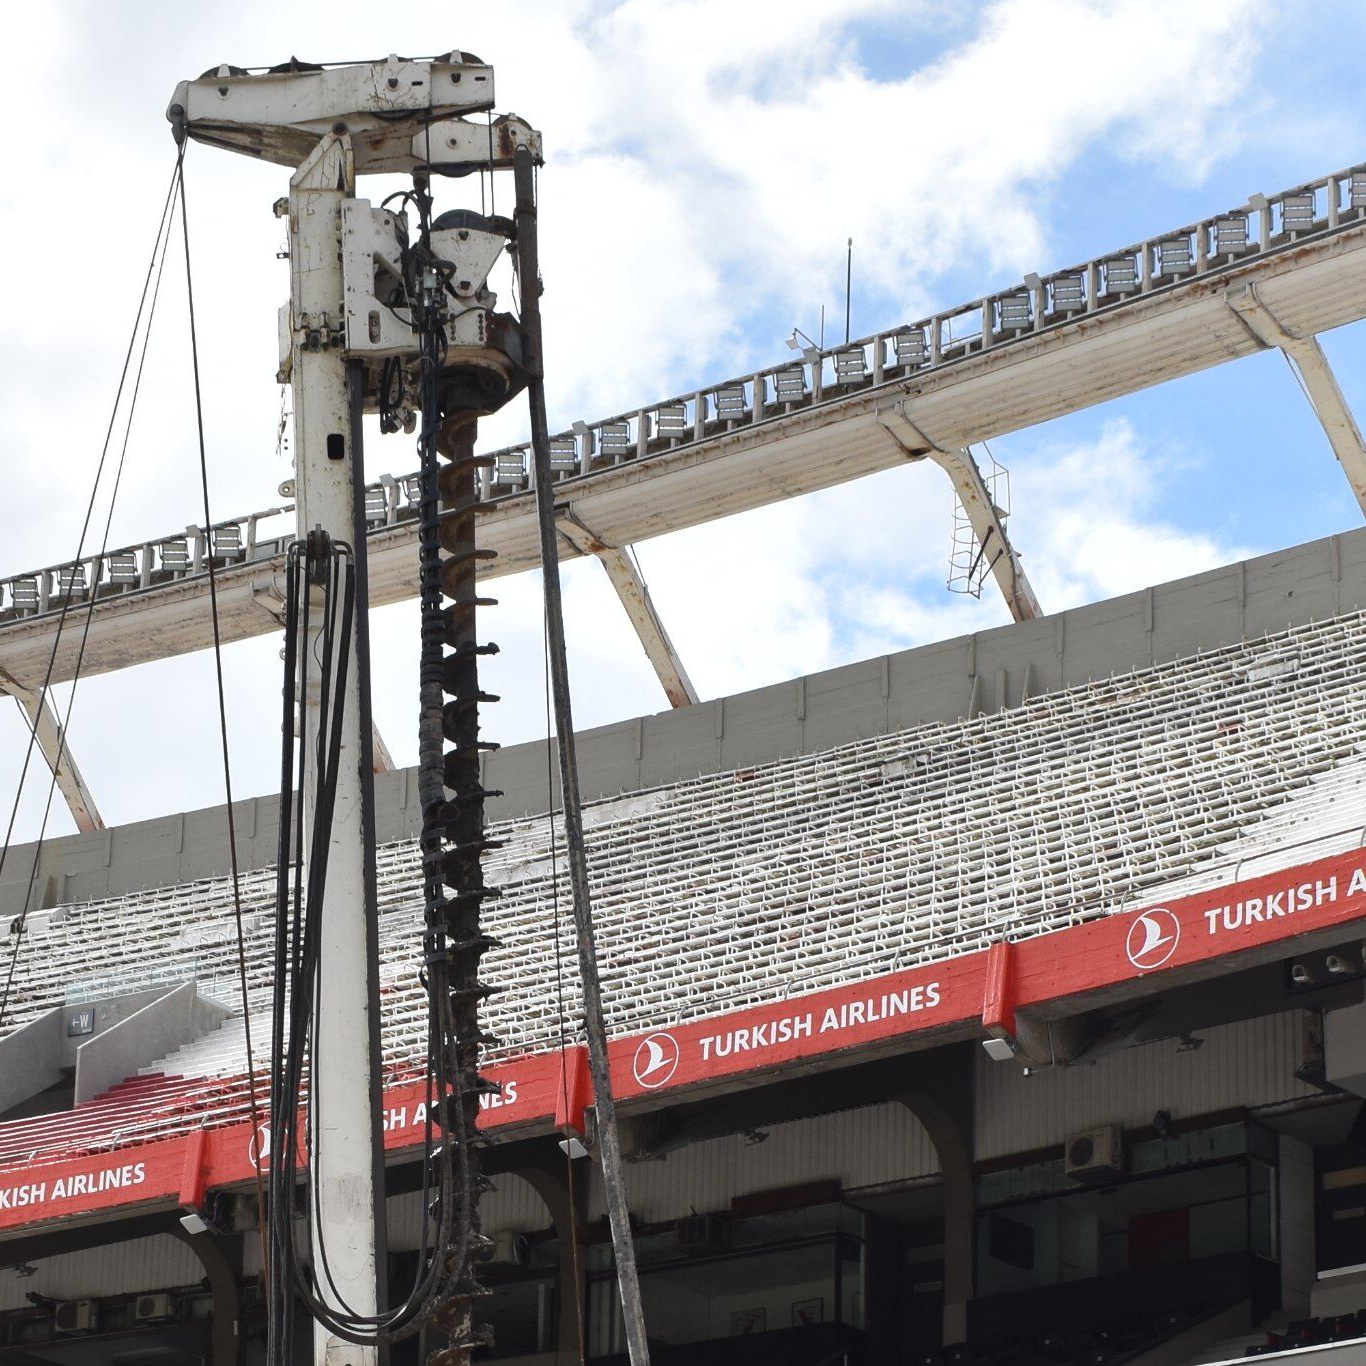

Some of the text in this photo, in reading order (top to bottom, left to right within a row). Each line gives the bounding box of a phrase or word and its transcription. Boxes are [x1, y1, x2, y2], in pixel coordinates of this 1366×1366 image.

[1204, 874, 1336, 935] TURKISH
[698, 982, 941, 1061] TURKISH AIRLINES
[50, 1162, 146, 1201] AIRLINES
